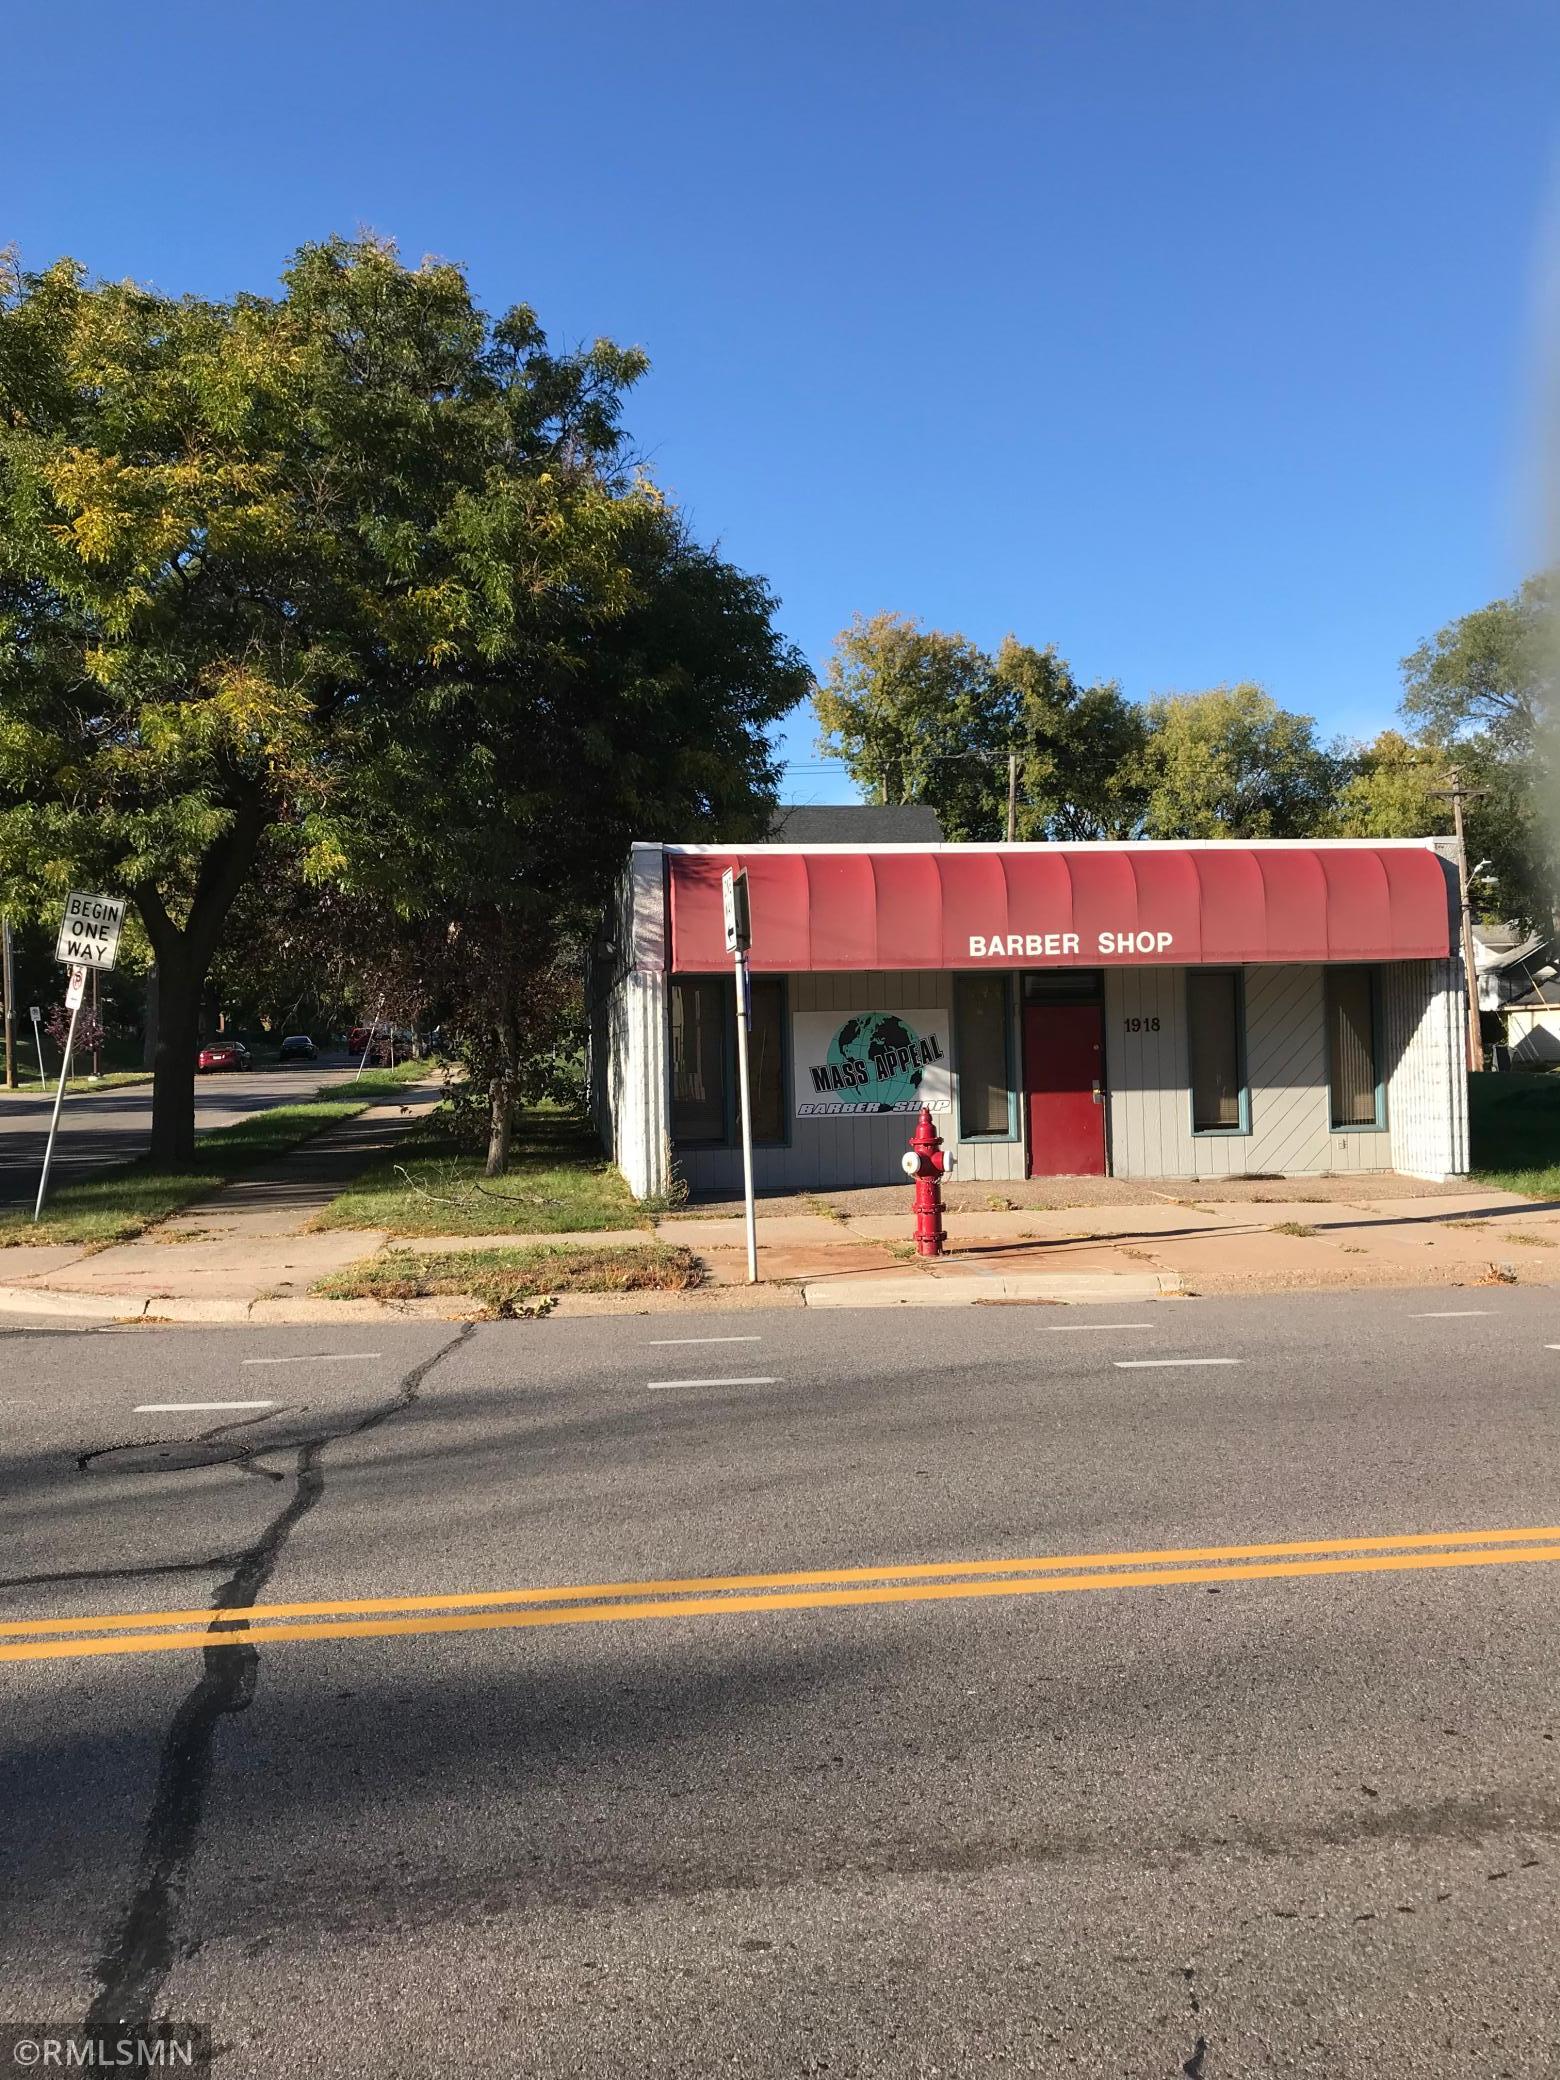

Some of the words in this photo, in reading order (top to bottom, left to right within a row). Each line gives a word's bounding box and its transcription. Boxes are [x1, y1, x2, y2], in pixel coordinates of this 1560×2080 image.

[70, 899, 119, 922] BEGIN
[72, 920, 110, 941] ONE
[67, 940, 107, 961] WAY
[969, 933, 1080, 957] BARBER
[1098, 931, 1173, 953] SHOP
[1124, 1017, 1160, 1032] 1918
[809, 1058, 870, 1093] MASS
[874, 1033, 945, 1082] APPEAL
[798, 1102, 881, 1115] BARBER
